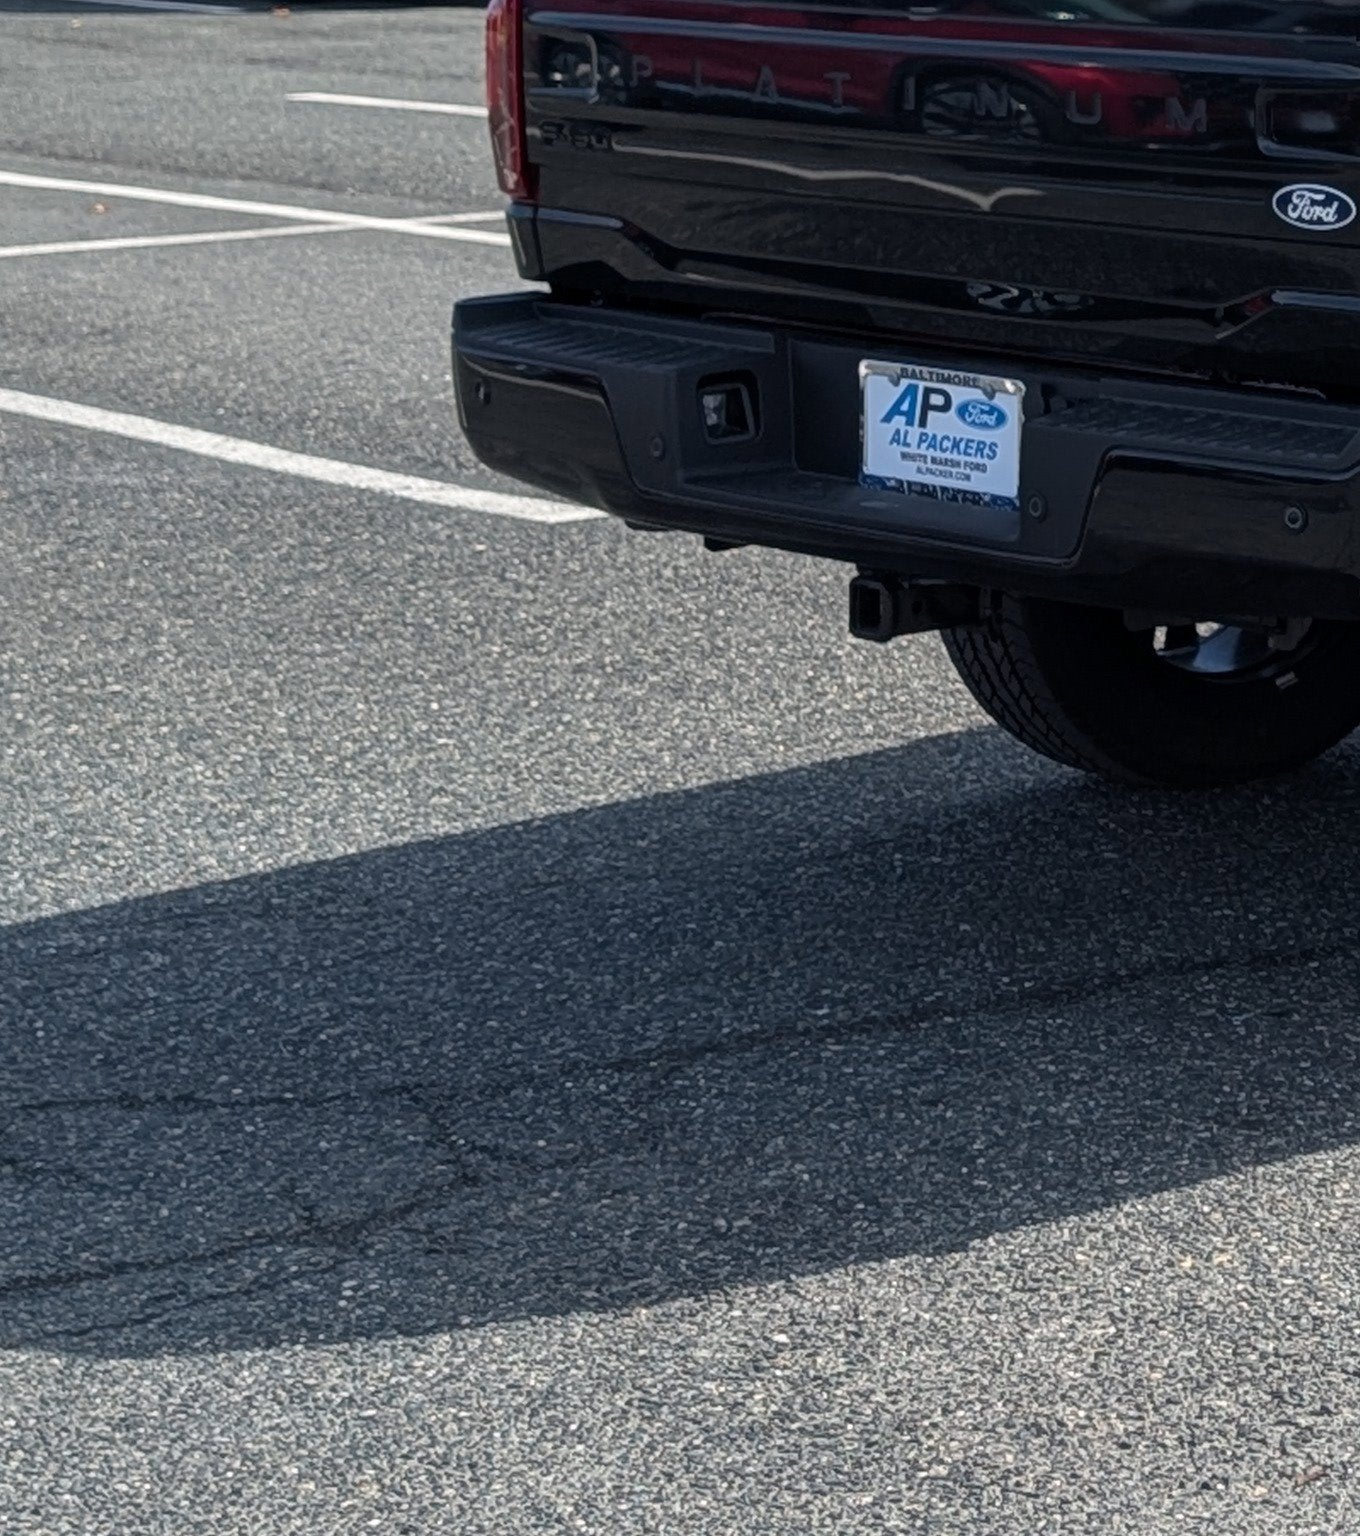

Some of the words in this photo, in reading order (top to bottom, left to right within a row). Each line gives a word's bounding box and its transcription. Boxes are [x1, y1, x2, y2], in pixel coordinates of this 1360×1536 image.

[632, 54, 1208, 133] PLATINUM
[900, 366, 981, 387] BALTIMORE
[880, 382, 952, 429] AP
[889, 427, 912, 449] AL
[916, 431, 999, 461] PACKERS
[900, 451, 929, 463] WHITE
[930, 454, 962, 468] MARSH
[962, 460, 988, 474] FORD
